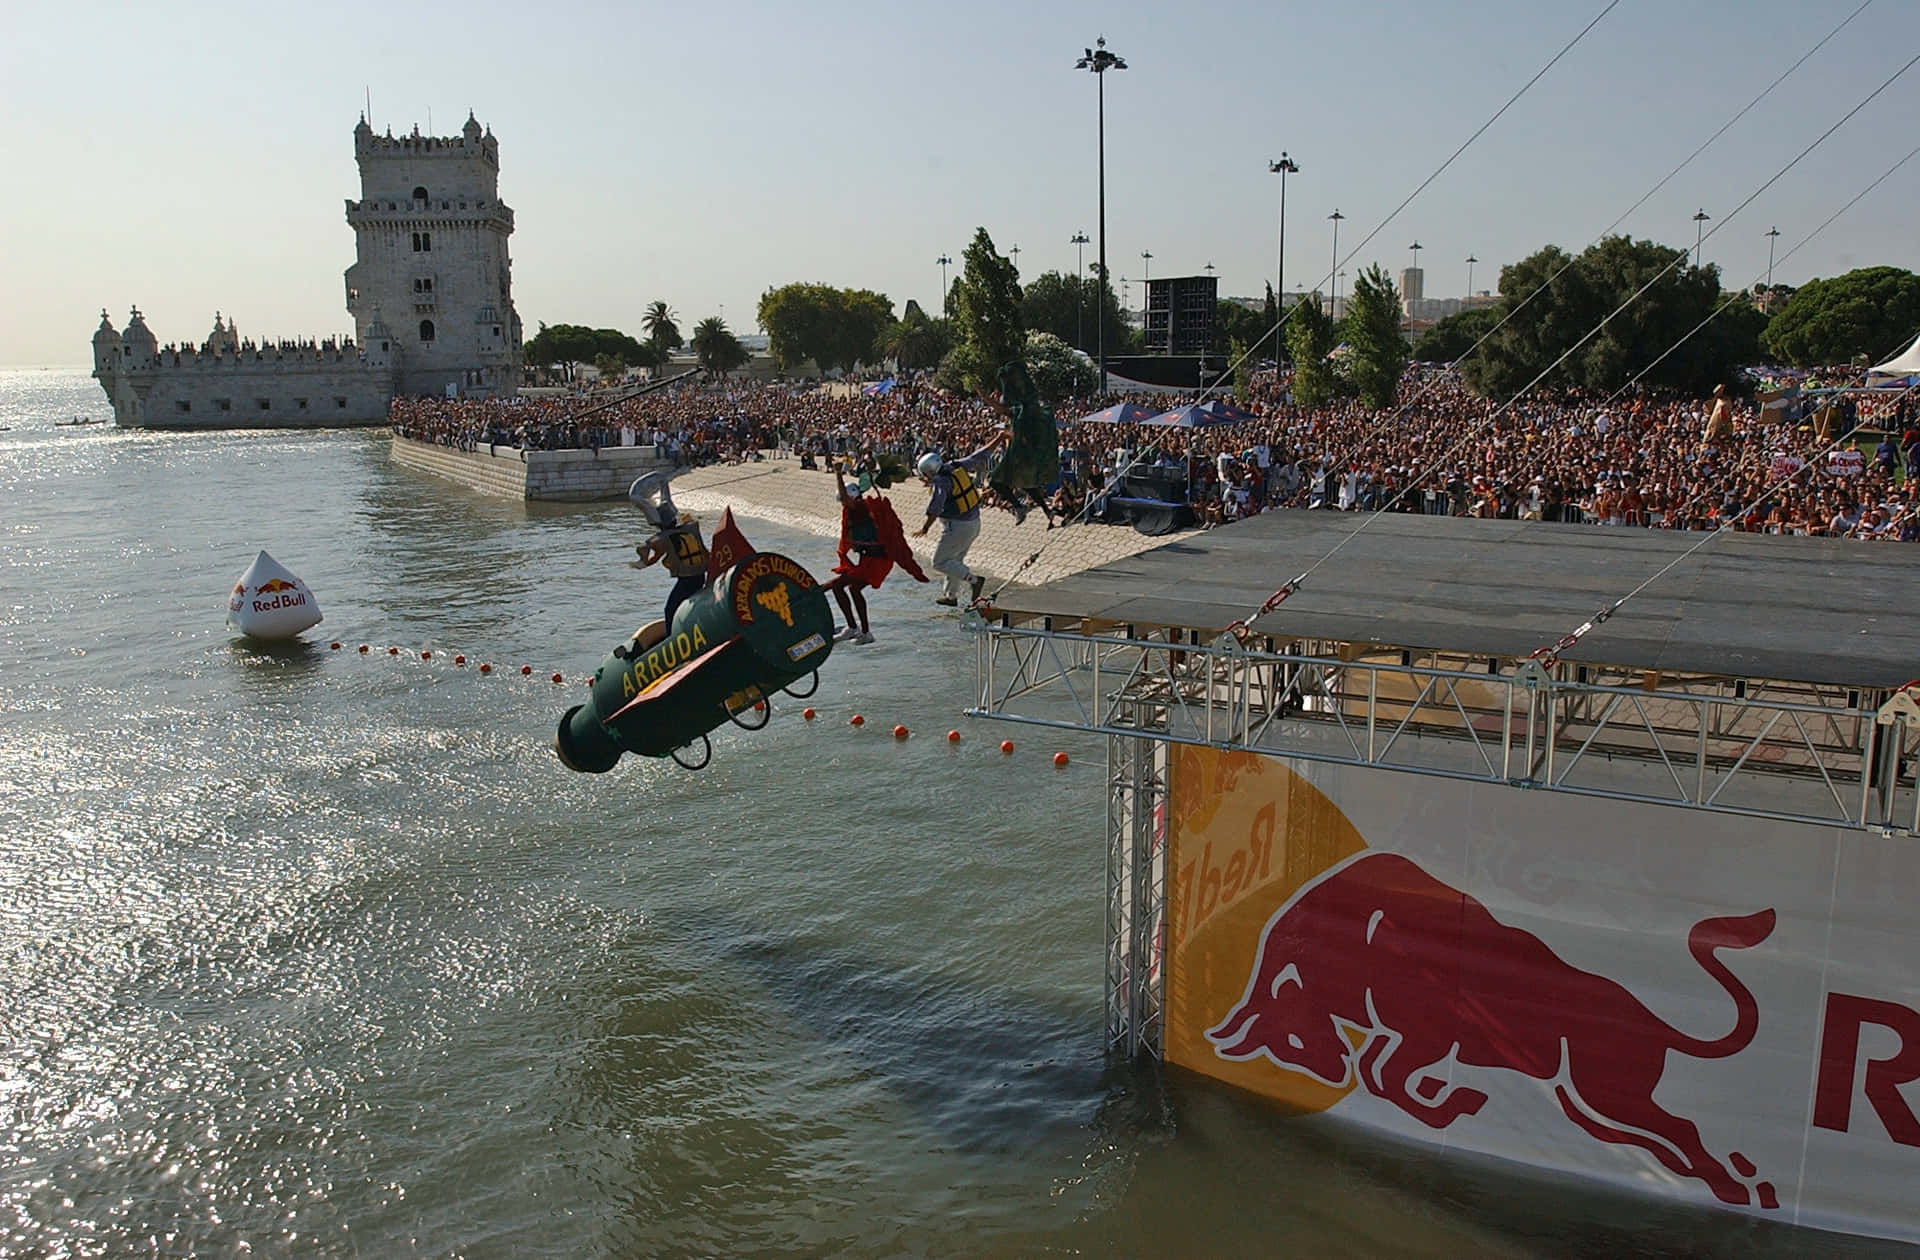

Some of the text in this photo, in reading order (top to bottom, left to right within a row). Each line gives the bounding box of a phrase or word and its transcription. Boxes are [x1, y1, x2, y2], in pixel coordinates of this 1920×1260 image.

[715, 544, 733, 567] 29
[252, 596, 281, 612] Red
[281, 594, 306, 608] Bull
[622, 623, 707, 697] ARRUDA
